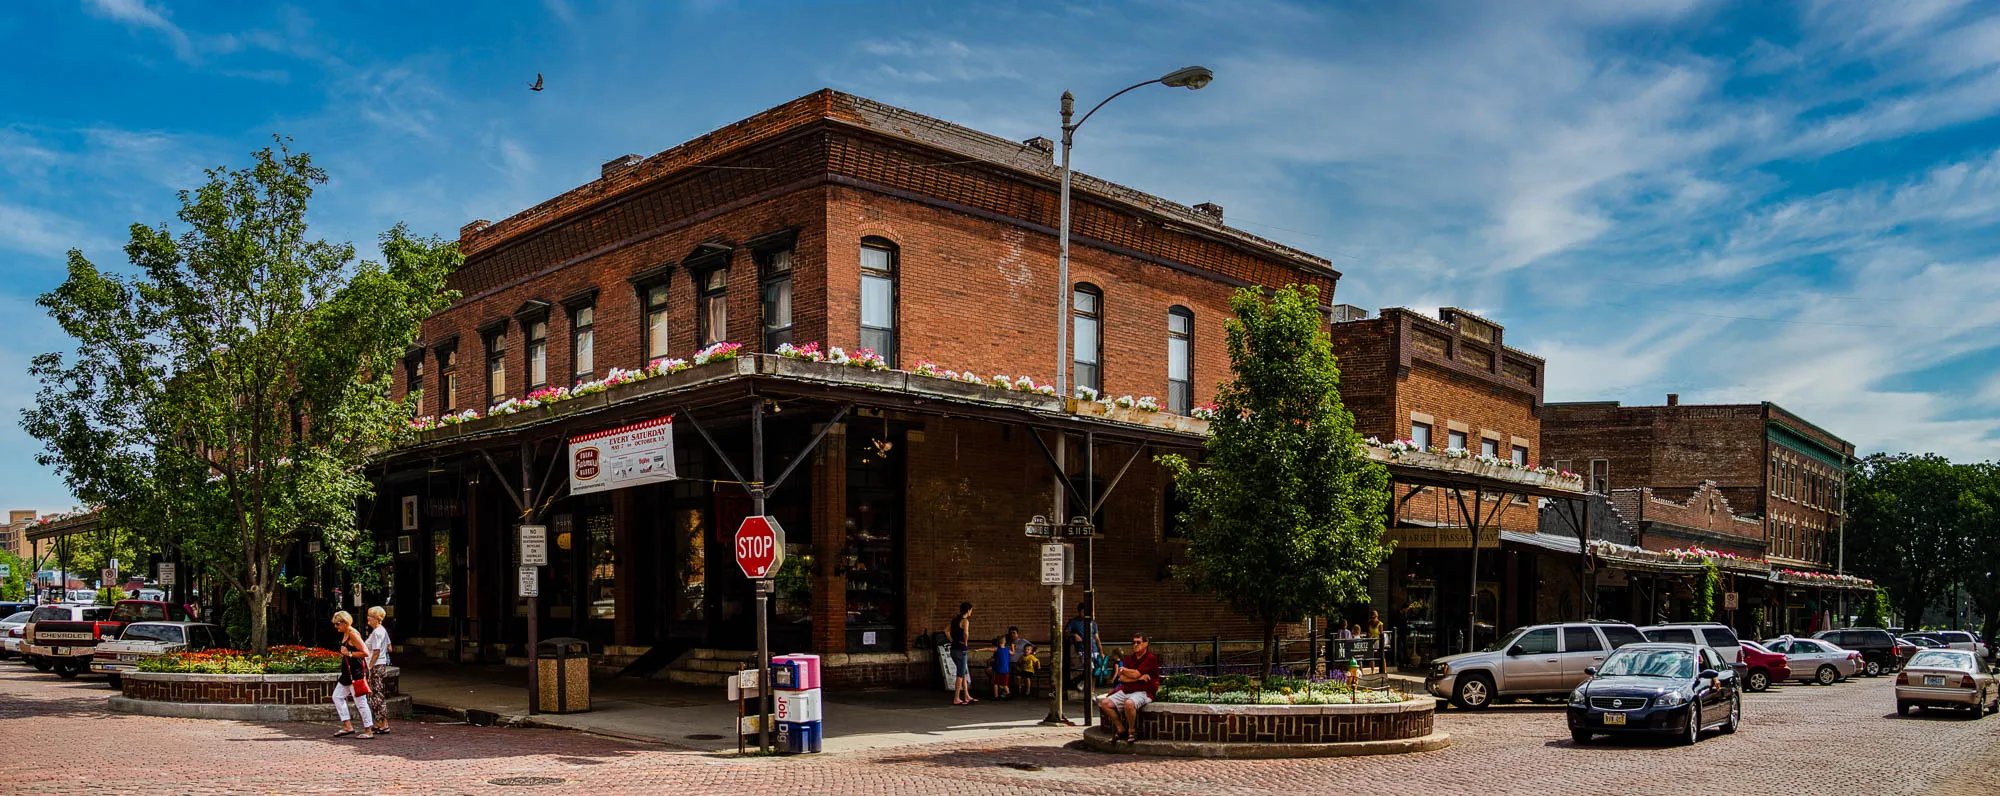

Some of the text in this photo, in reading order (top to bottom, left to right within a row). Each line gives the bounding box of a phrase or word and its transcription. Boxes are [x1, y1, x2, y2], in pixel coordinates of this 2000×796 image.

[609, 427, 666, 446] EVERY SATURDAY
[634, 438, 657, 447] OCTOBER
[1075, 527, 1081, 535] 11
[1401, 533, 1437, 542] MARKET
[1440, 533, 1495, 542] PASSAGWAY
[738, 535, 773, 559] STOP
[777, 696, 788, 719] Job
[776, 723, 789, 744] Dig
